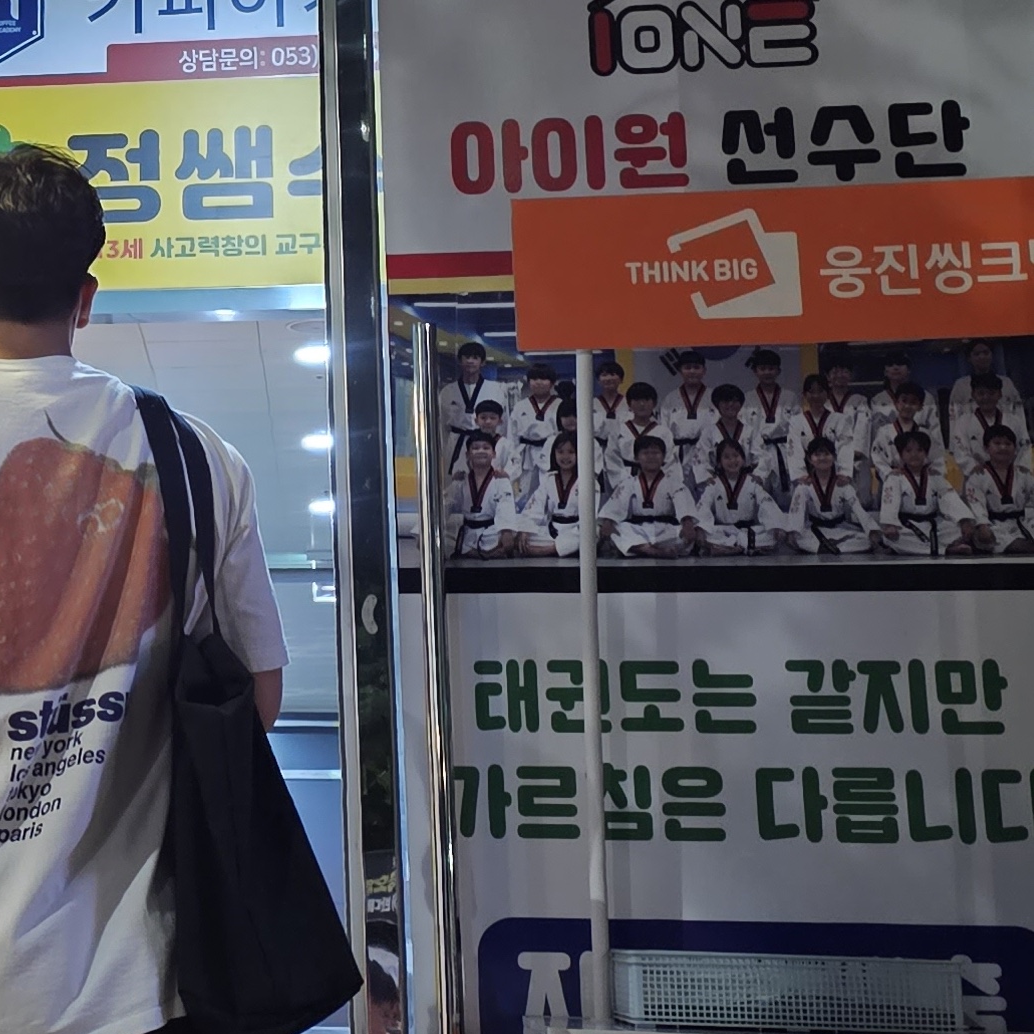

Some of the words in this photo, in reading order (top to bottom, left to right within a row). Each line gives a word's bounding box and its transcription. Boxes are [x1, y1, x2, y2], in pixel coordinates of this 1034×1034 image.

[450, 111, 690, 195] 아이원
[722, 100, 971, 185] 선수단
[150, 233, 267, 259] 사고력창의
[625, 259, 707, 284] THINK
[713, 258, 758, 281] BIG
[820, 240, 1034, 299] 웅진씽크
[473, 658, 757, 734] 태권도는
[785, 658, 1008, 735] 같지만
[32, 749, 106, 777] angeles
[41, 731, 84, 759] york
[454, 763, 727, 841] 가르침은
